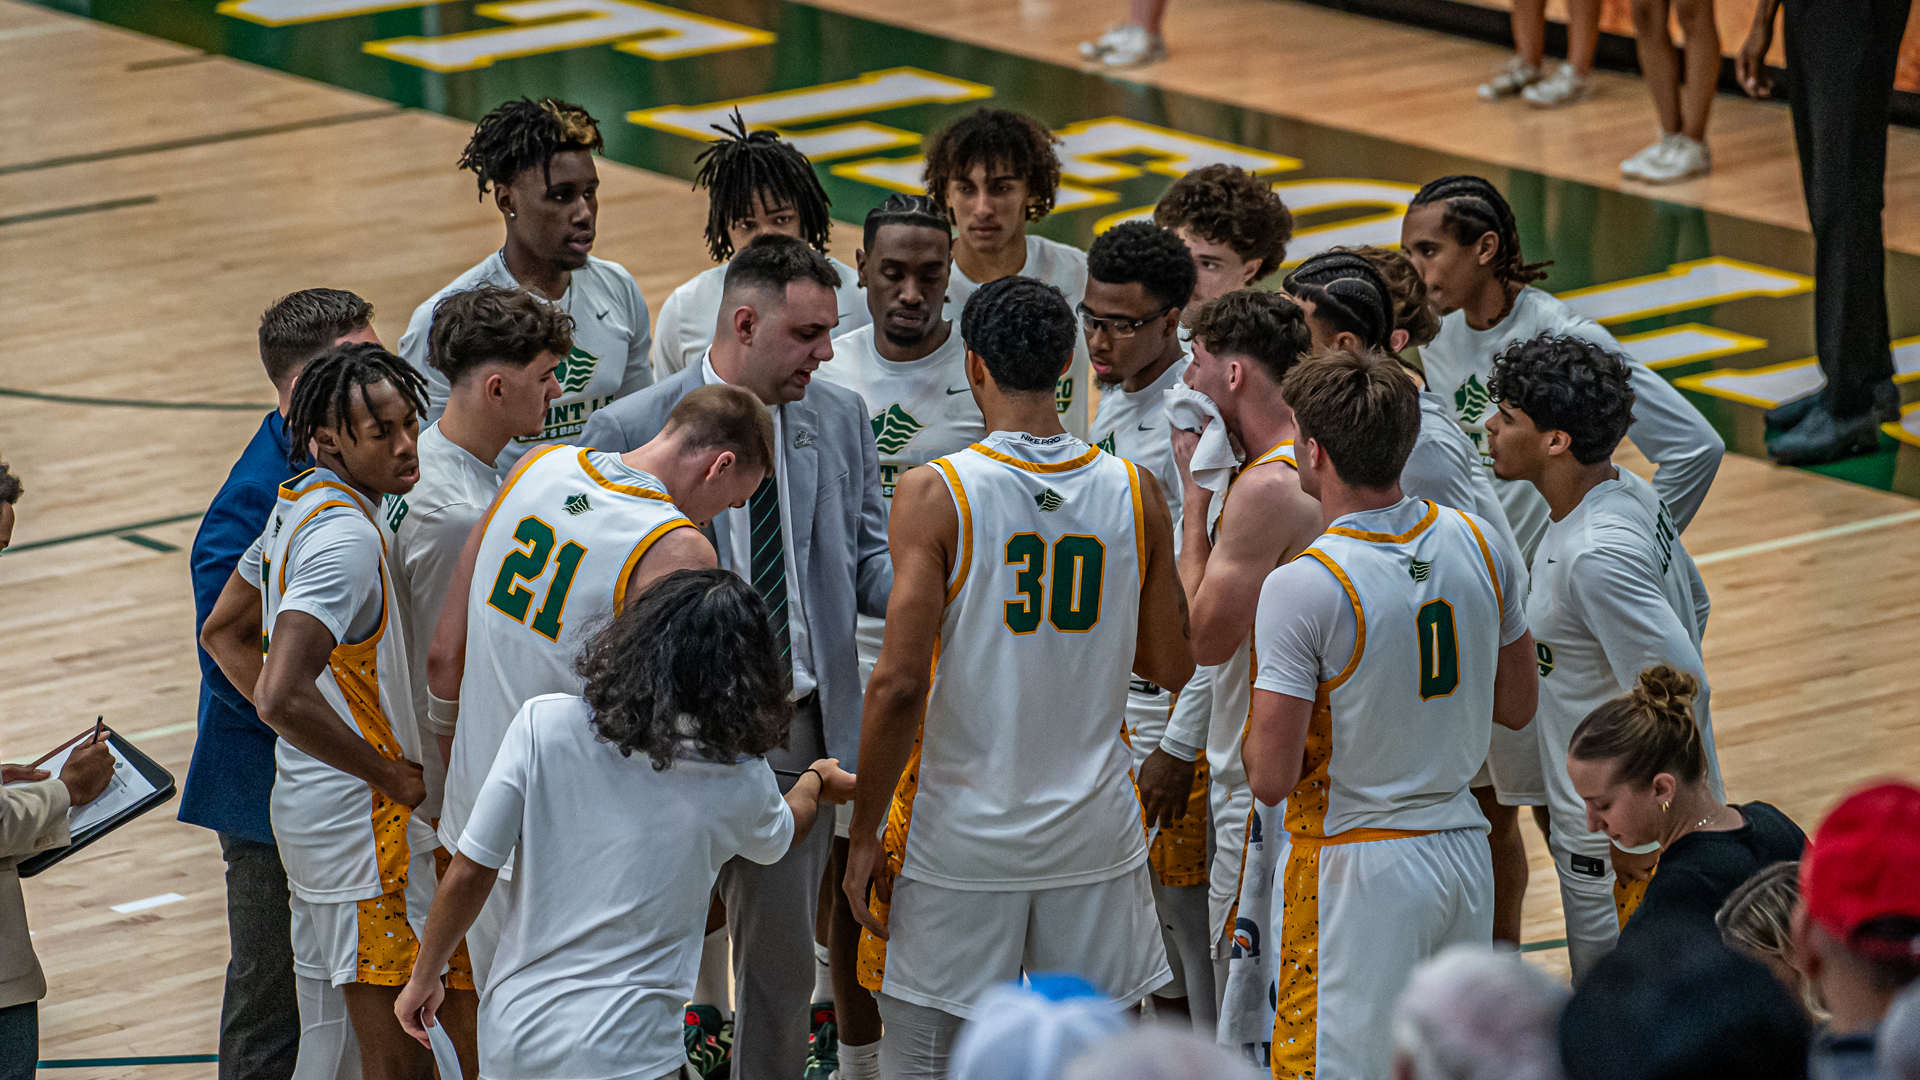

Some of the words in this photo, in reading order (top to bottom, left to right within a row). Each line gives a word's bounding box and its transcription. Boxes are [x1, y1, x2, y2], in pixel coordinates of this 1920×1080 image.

[1020, 434, 1040, 445] NIKE
[1041, 436, 1061, 445] PRO
[486, 514, 588, 643] 21
[1003, 531, 1107, 636] 30
[1415, 596, 1460, 702] 0
